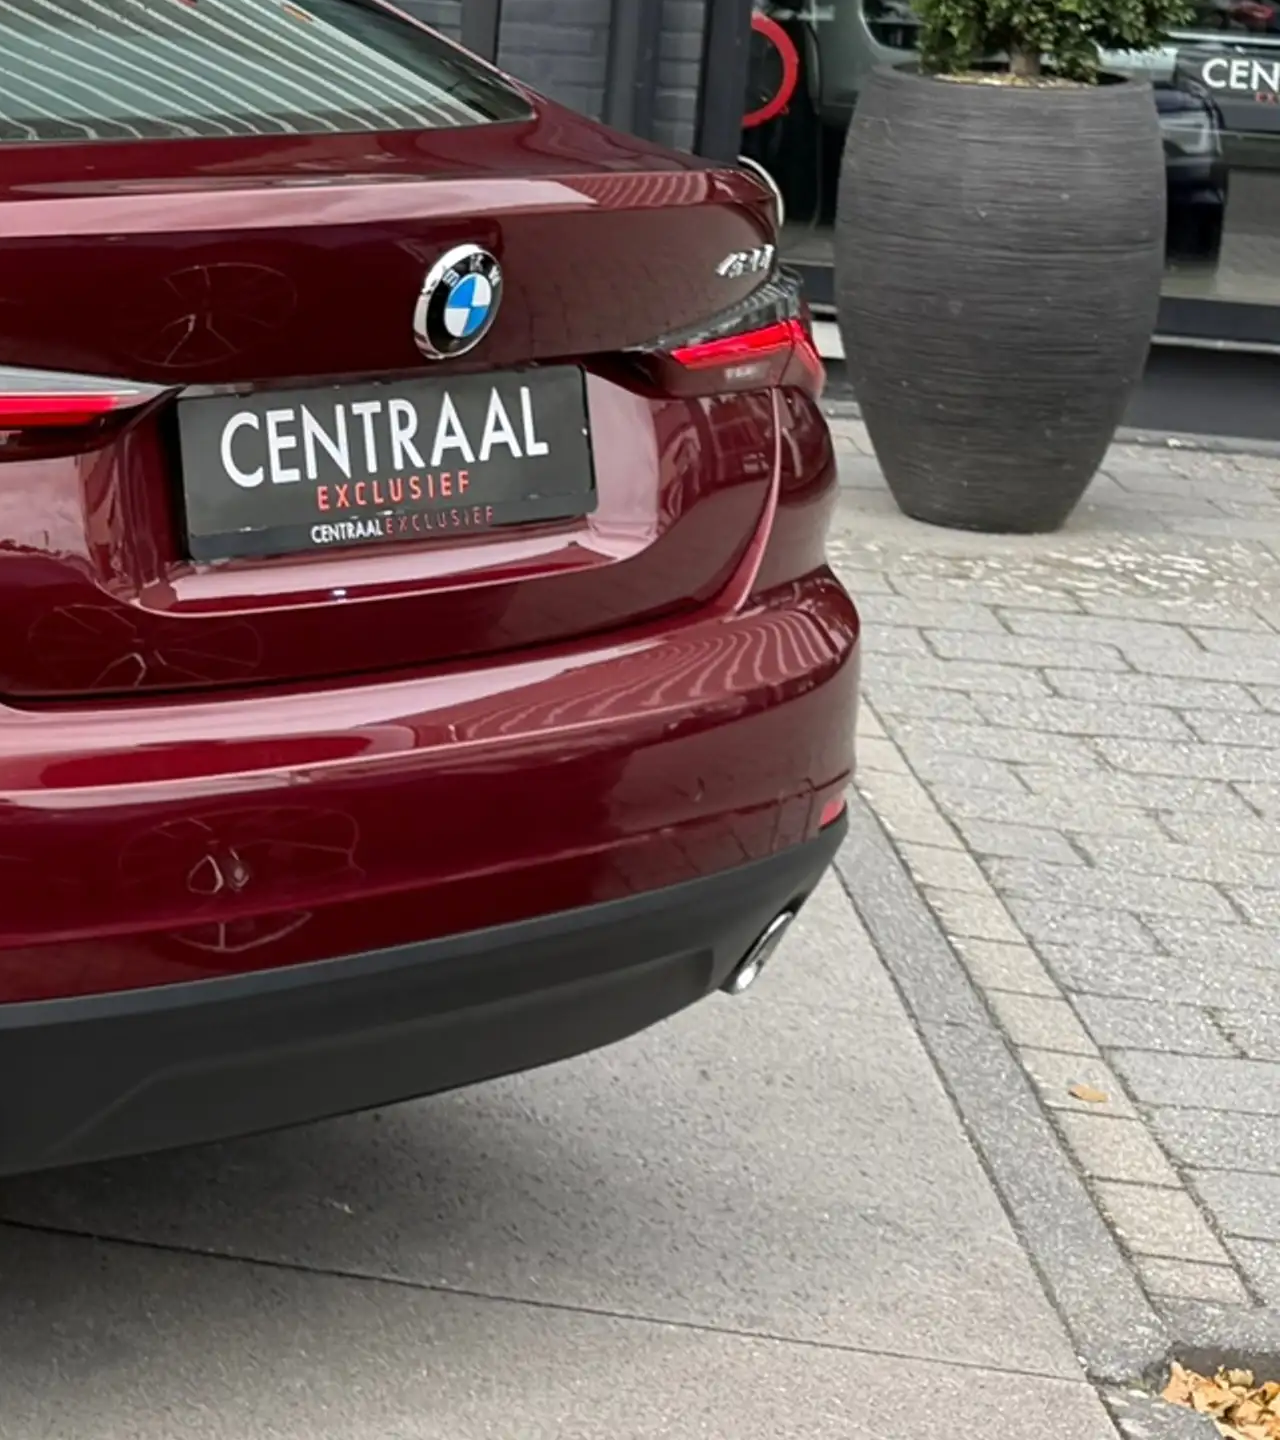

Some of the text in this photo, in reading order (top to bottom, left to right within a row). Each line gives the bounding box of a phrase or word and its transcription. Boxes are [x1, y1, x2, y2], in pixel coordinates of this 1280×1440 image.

[442, 253, 501, 287] BMW
[221, 386, 549, 488] CENTRAAL
[317, 470, 471, 511] EXCLUSIEF
[310, 506, 494, 544] CENTRAAL EXCLUSIEF
